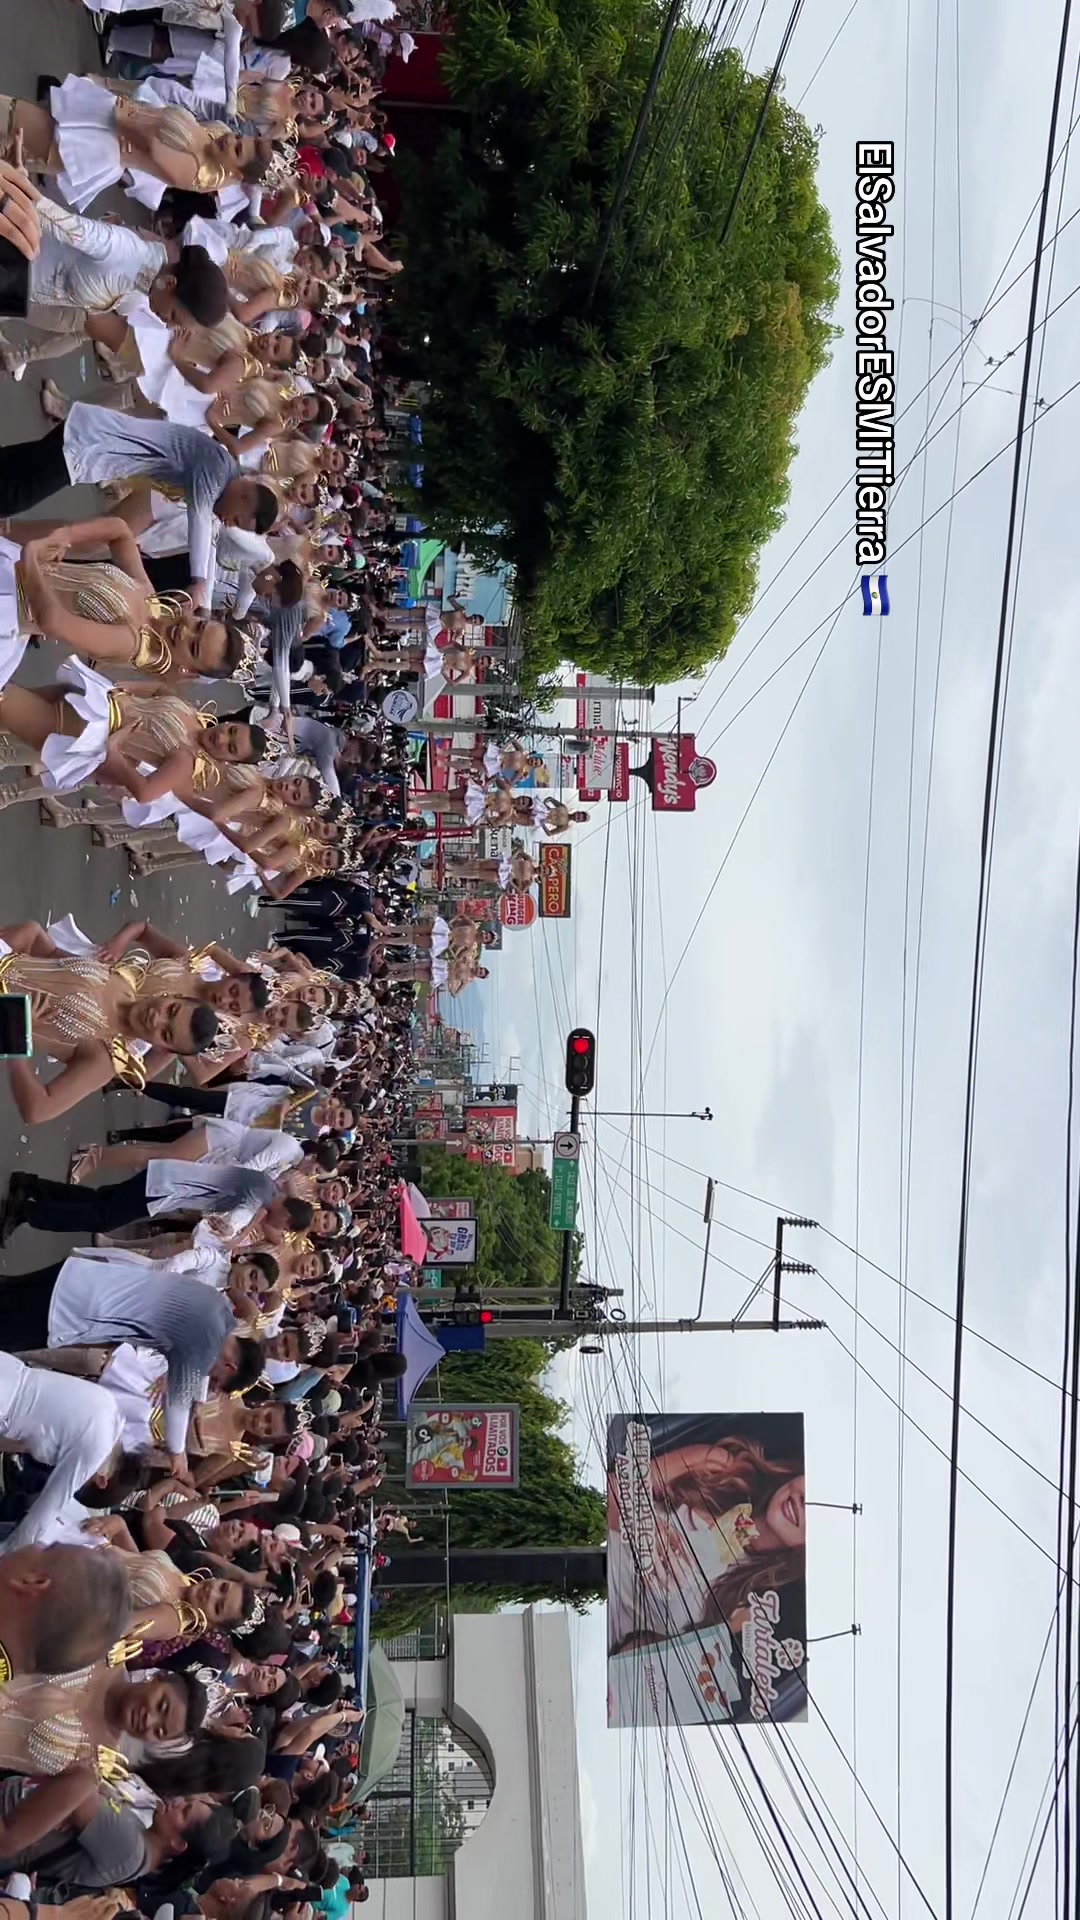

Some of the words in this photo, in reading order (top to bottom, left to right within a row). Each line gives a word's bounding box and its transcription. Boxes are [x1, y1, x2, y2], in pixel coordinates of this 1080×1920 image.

[593, 745, 609, 776] Value
[615, 745, 623, 798] AUTOSERVICIO
[656, 737, 686, 805] Wendy's
[547, 848, 560, 912] CAMPERO
[506, 895, 516, 925] KING
[516, 895, 524, 925] BURGER
[499, 1429, 507, 1445] VOS
[500, 1415, 508, 1428] POR
[485, 1414, 498, 1473] ILIMITADOS
[619, 1457, 629, 1468] A
[619, 1474, 630, 1500] 200
[632, 1425, 654, 1572] AUTOSERVICIO
[619, 1506, 633, 1542] MTS
[749, 1594, 778, 1718] Tartaleta
